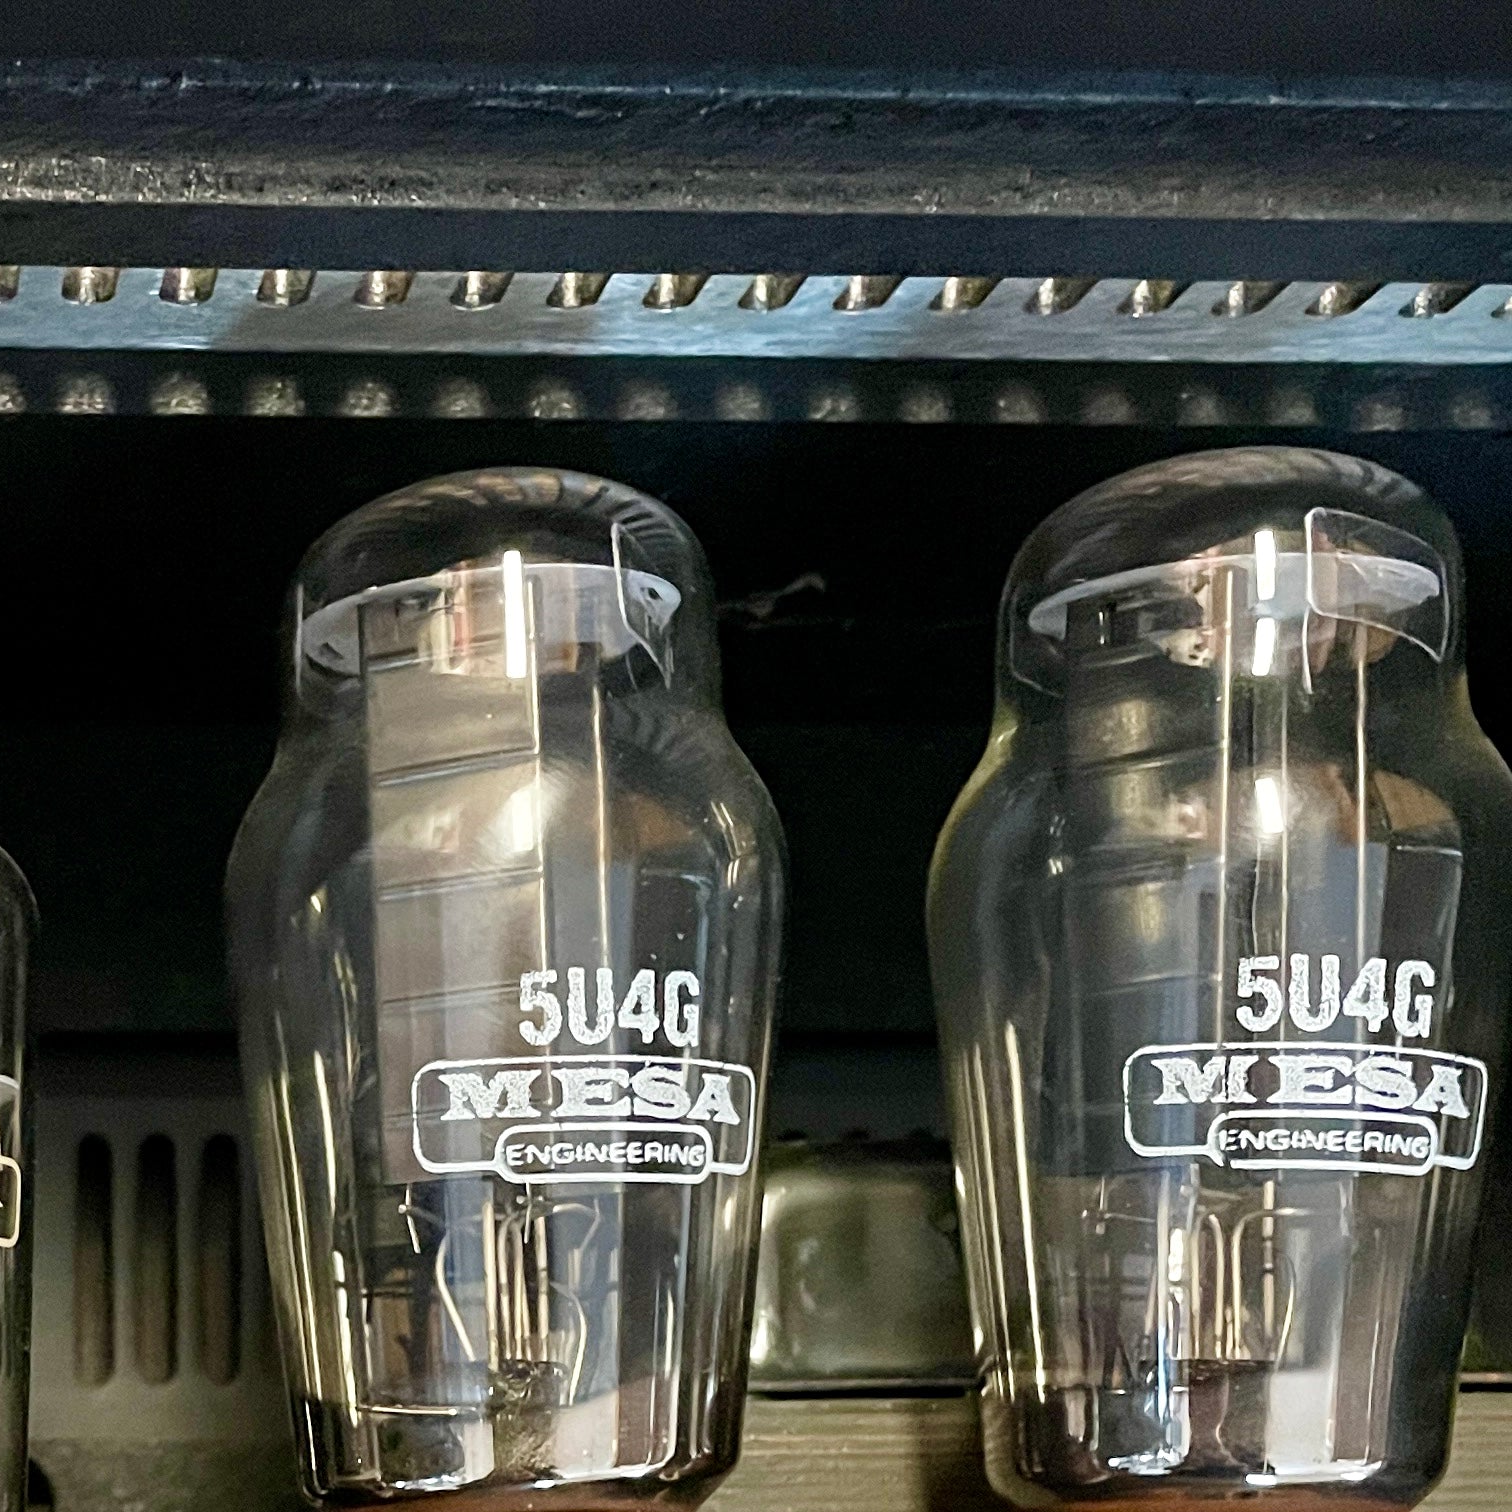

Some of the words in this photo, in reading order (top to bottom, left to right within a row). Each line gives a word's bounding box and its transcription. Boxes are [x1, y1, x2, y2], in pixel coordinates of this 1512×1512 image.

[519, 967, 700, 1048] 5U4G
[1235, 953, 1435, 1038] 5U4G
[439, 1065, 741, 1126] MESA
[1151, 1054, 1470, 1119] MESA
[505, 1143, 705, 1167] ENGINEERING
[1218, 1128, 1430, 1159] ENGINEERING
